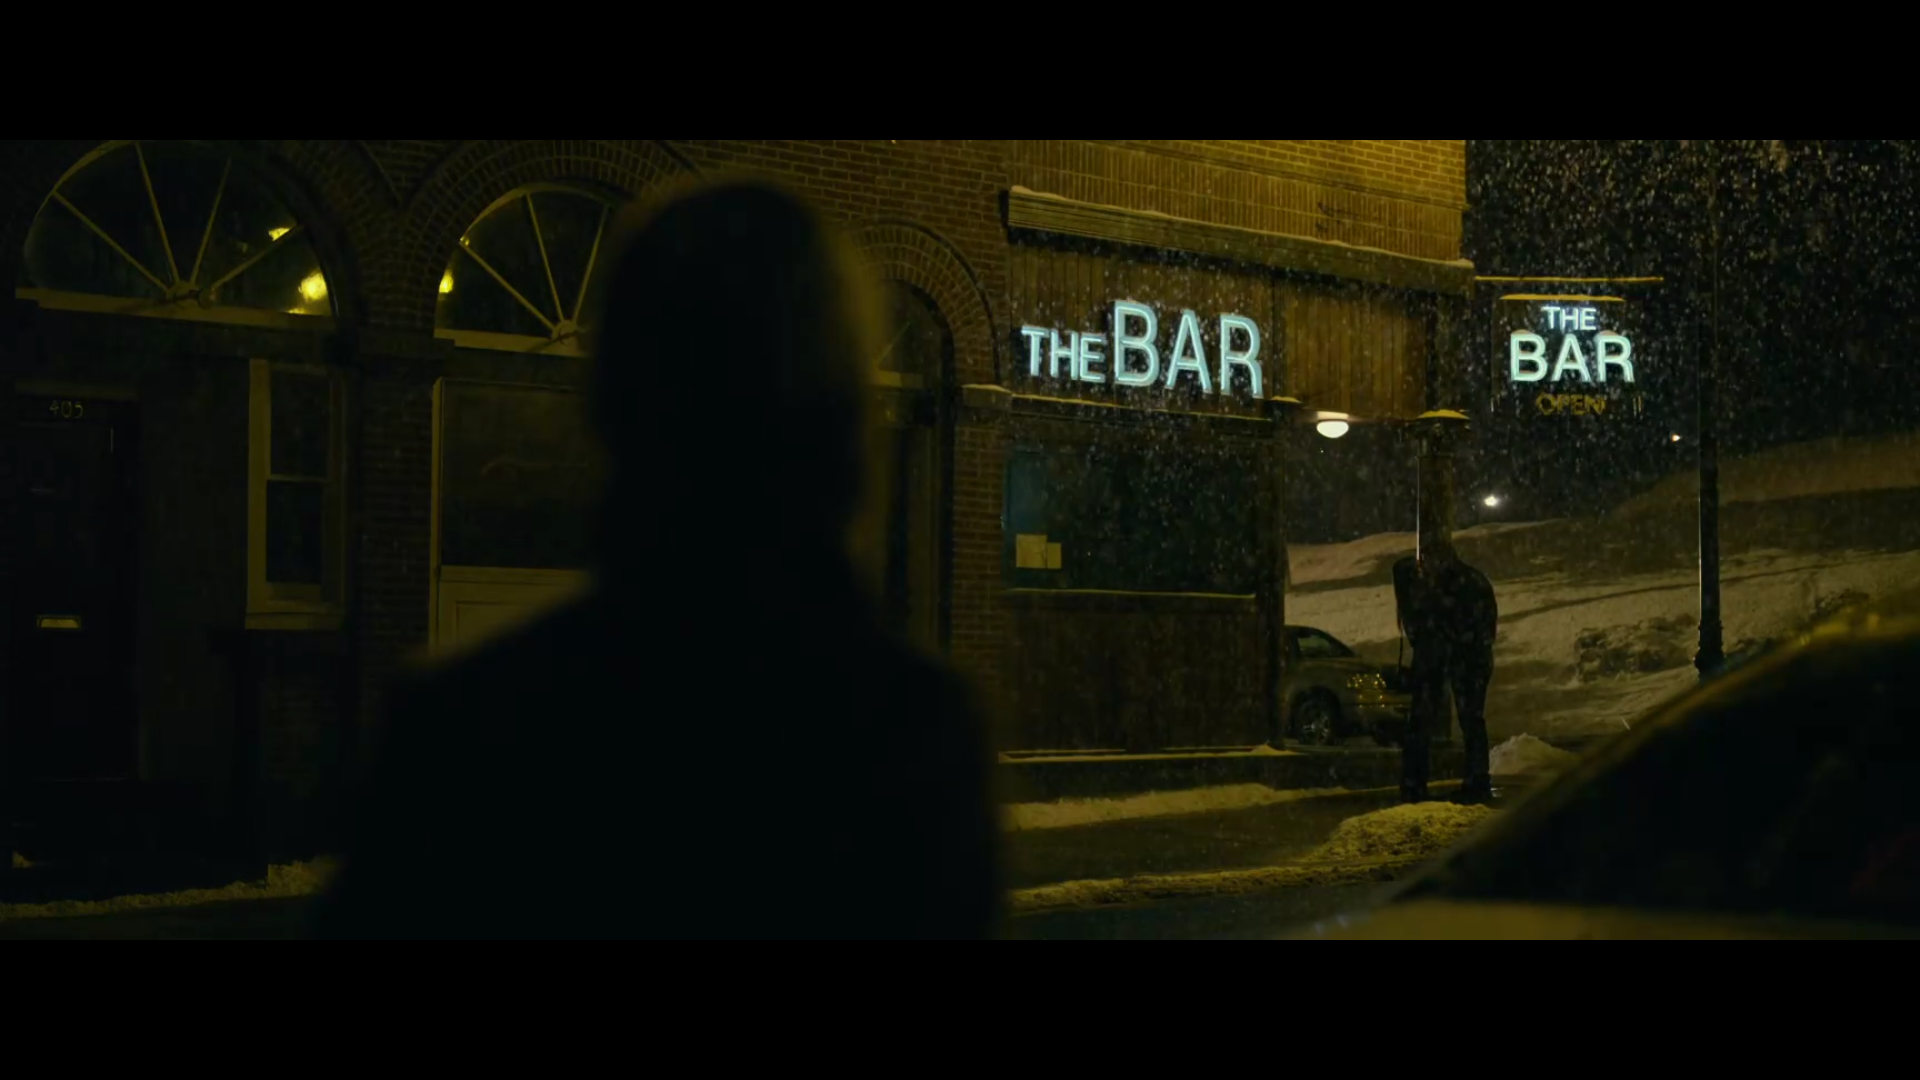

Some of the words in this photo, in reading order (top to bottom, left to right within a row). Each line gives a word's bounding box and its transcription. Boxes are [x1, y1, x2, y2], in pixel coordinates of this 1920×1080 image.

[1541, 306, 1597, 330] THE
[1020, 324, 1107, 383] THE
[1113, 300, 1264, 399] BAR
[1510, 332, 1635, 382] BAR
[49, 399, 85, 419] 405
[1536, 392, 1606, 415] OPEN
